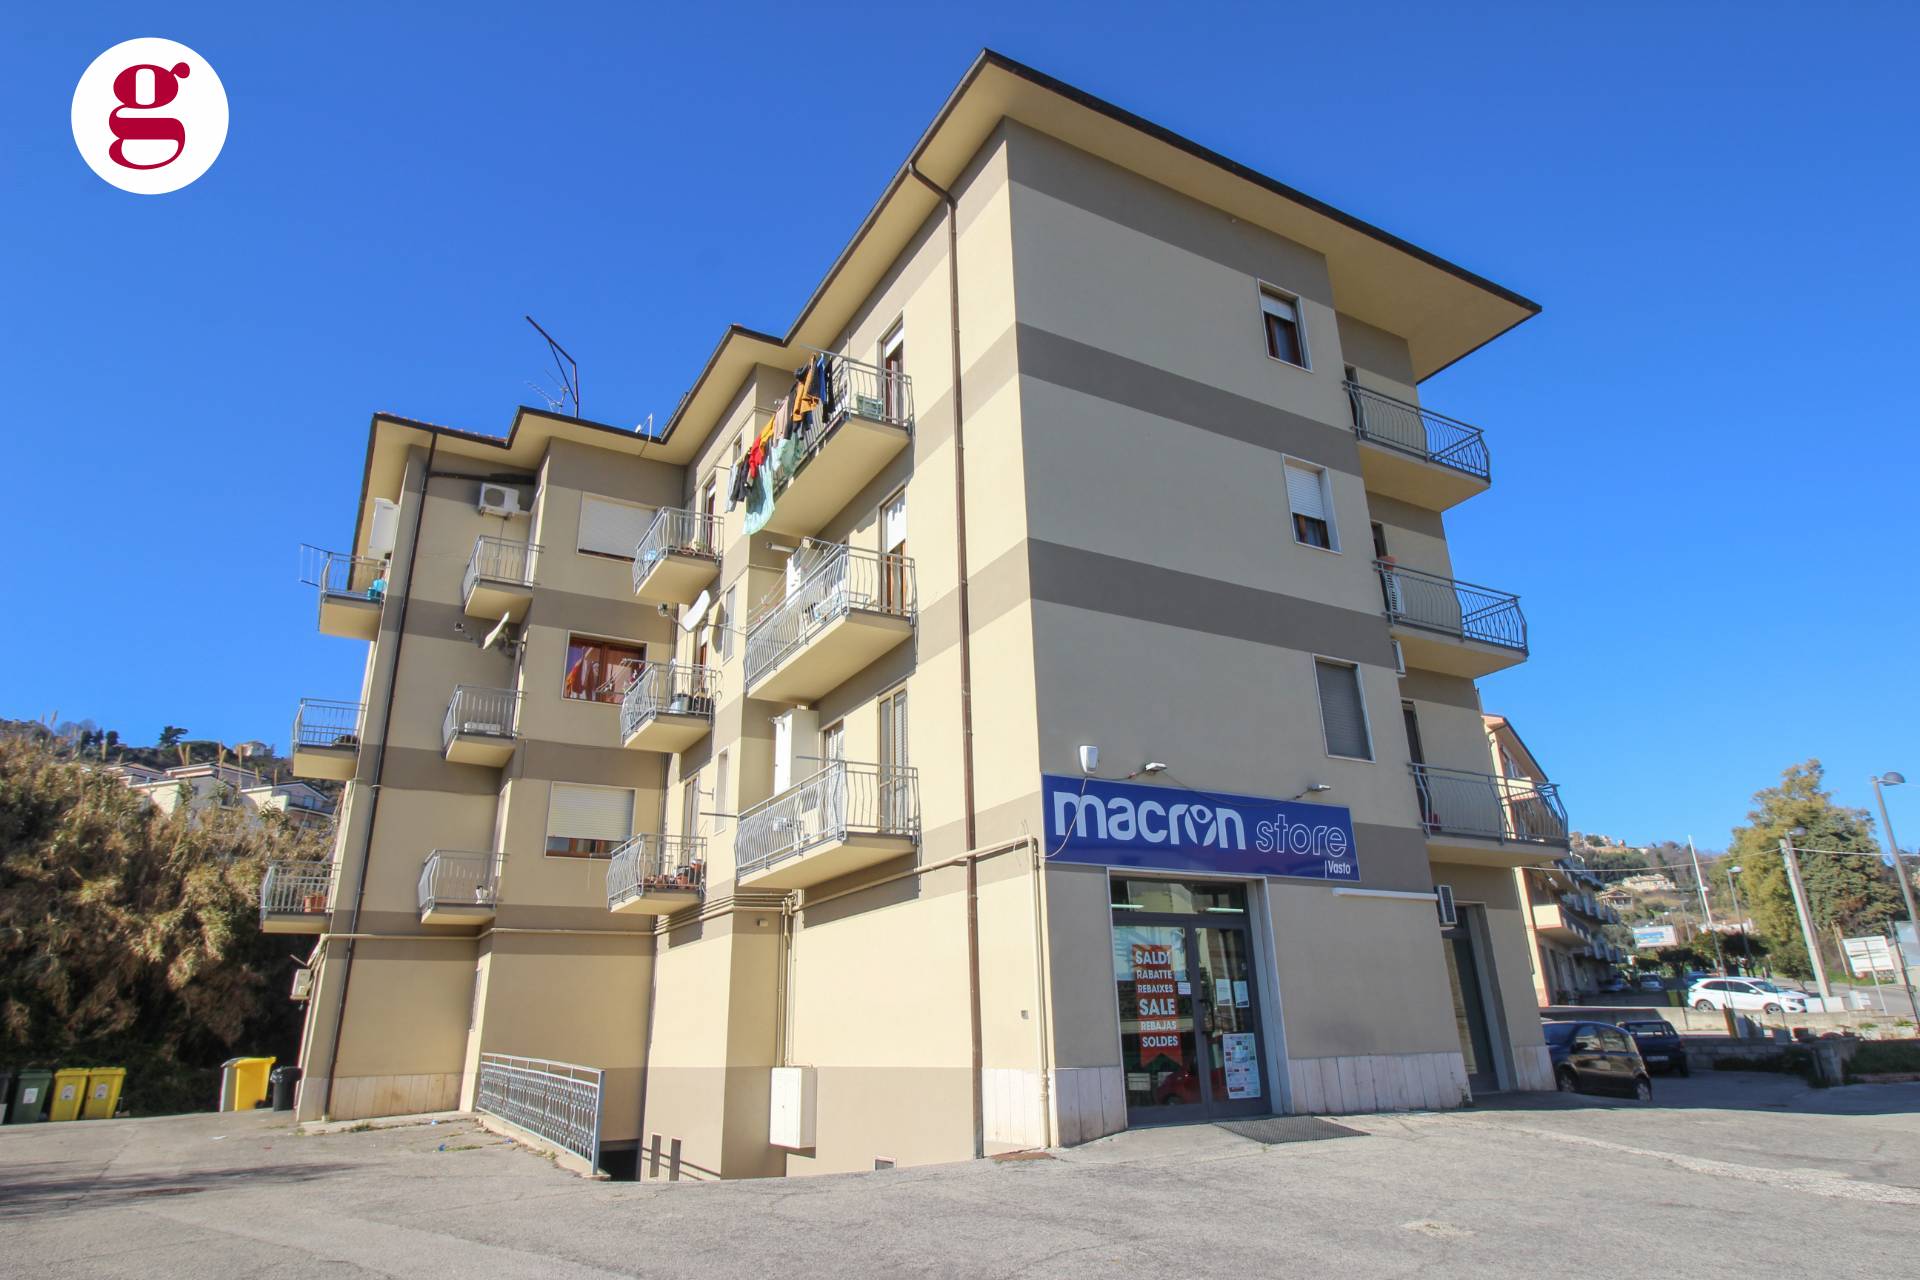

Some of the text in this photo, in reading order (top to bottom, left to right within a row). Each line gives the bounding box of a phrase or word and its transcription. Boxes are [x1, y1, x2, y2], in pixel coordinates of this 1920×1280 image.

[1053, 791, 1347, 857] macron store
[1327, 860, 1351, 875] Vasto
[1135, 951, 1172, 965] SALDI
[1136, 970, 1173, 980] RABATTE
[1137, 984, 1174, 994] REBAIXES
[1139, 999, 1176, 1016] SALE
[1141, 1021, 1177, 1031] REBAJAS
[1142, 1036, 1178, 1047] SOLDES
